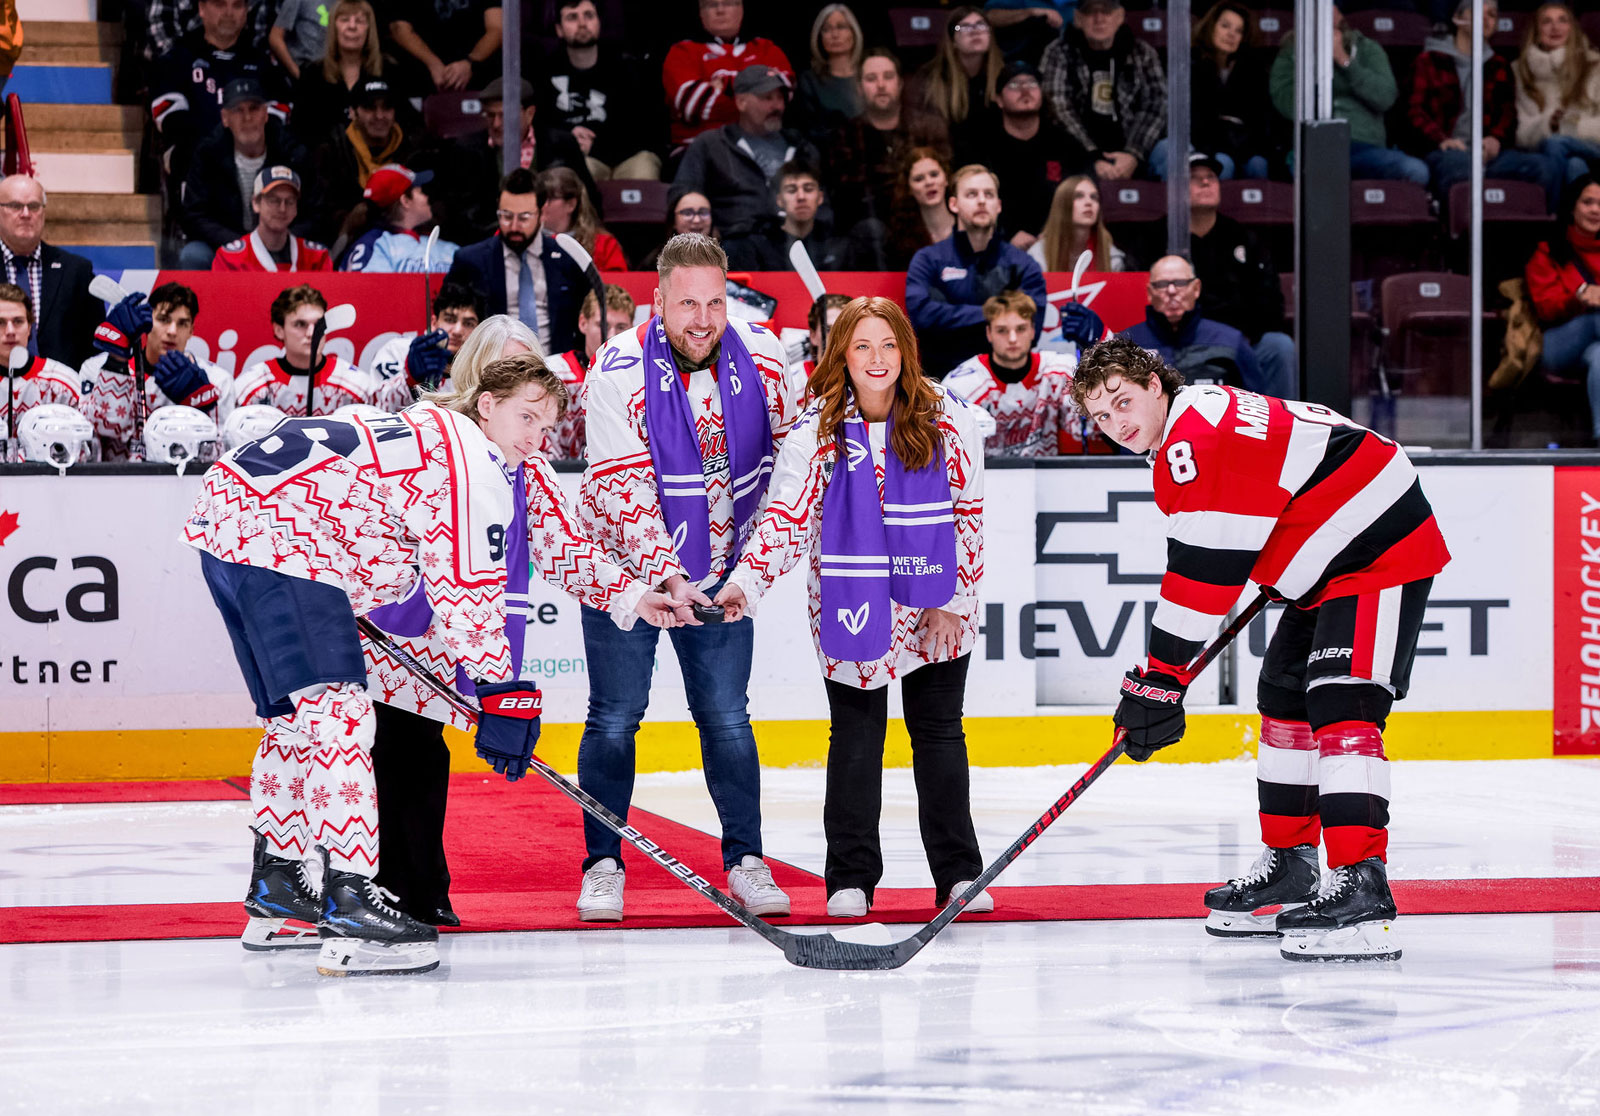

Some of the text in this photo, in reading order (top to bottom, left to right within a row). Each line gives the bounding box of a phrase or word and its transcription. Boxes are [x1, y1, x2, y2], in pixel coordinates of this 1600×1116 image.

[1166, 439, 1200, 486] 8
[892, 556, 928, 566] WE'RE
[892, 564, 943, 576] ALL EARS
[0, 655, 118, 684] tner
[1121, 677, 1181, 705] AUER
[617, 825, 711, 891] BAUER
